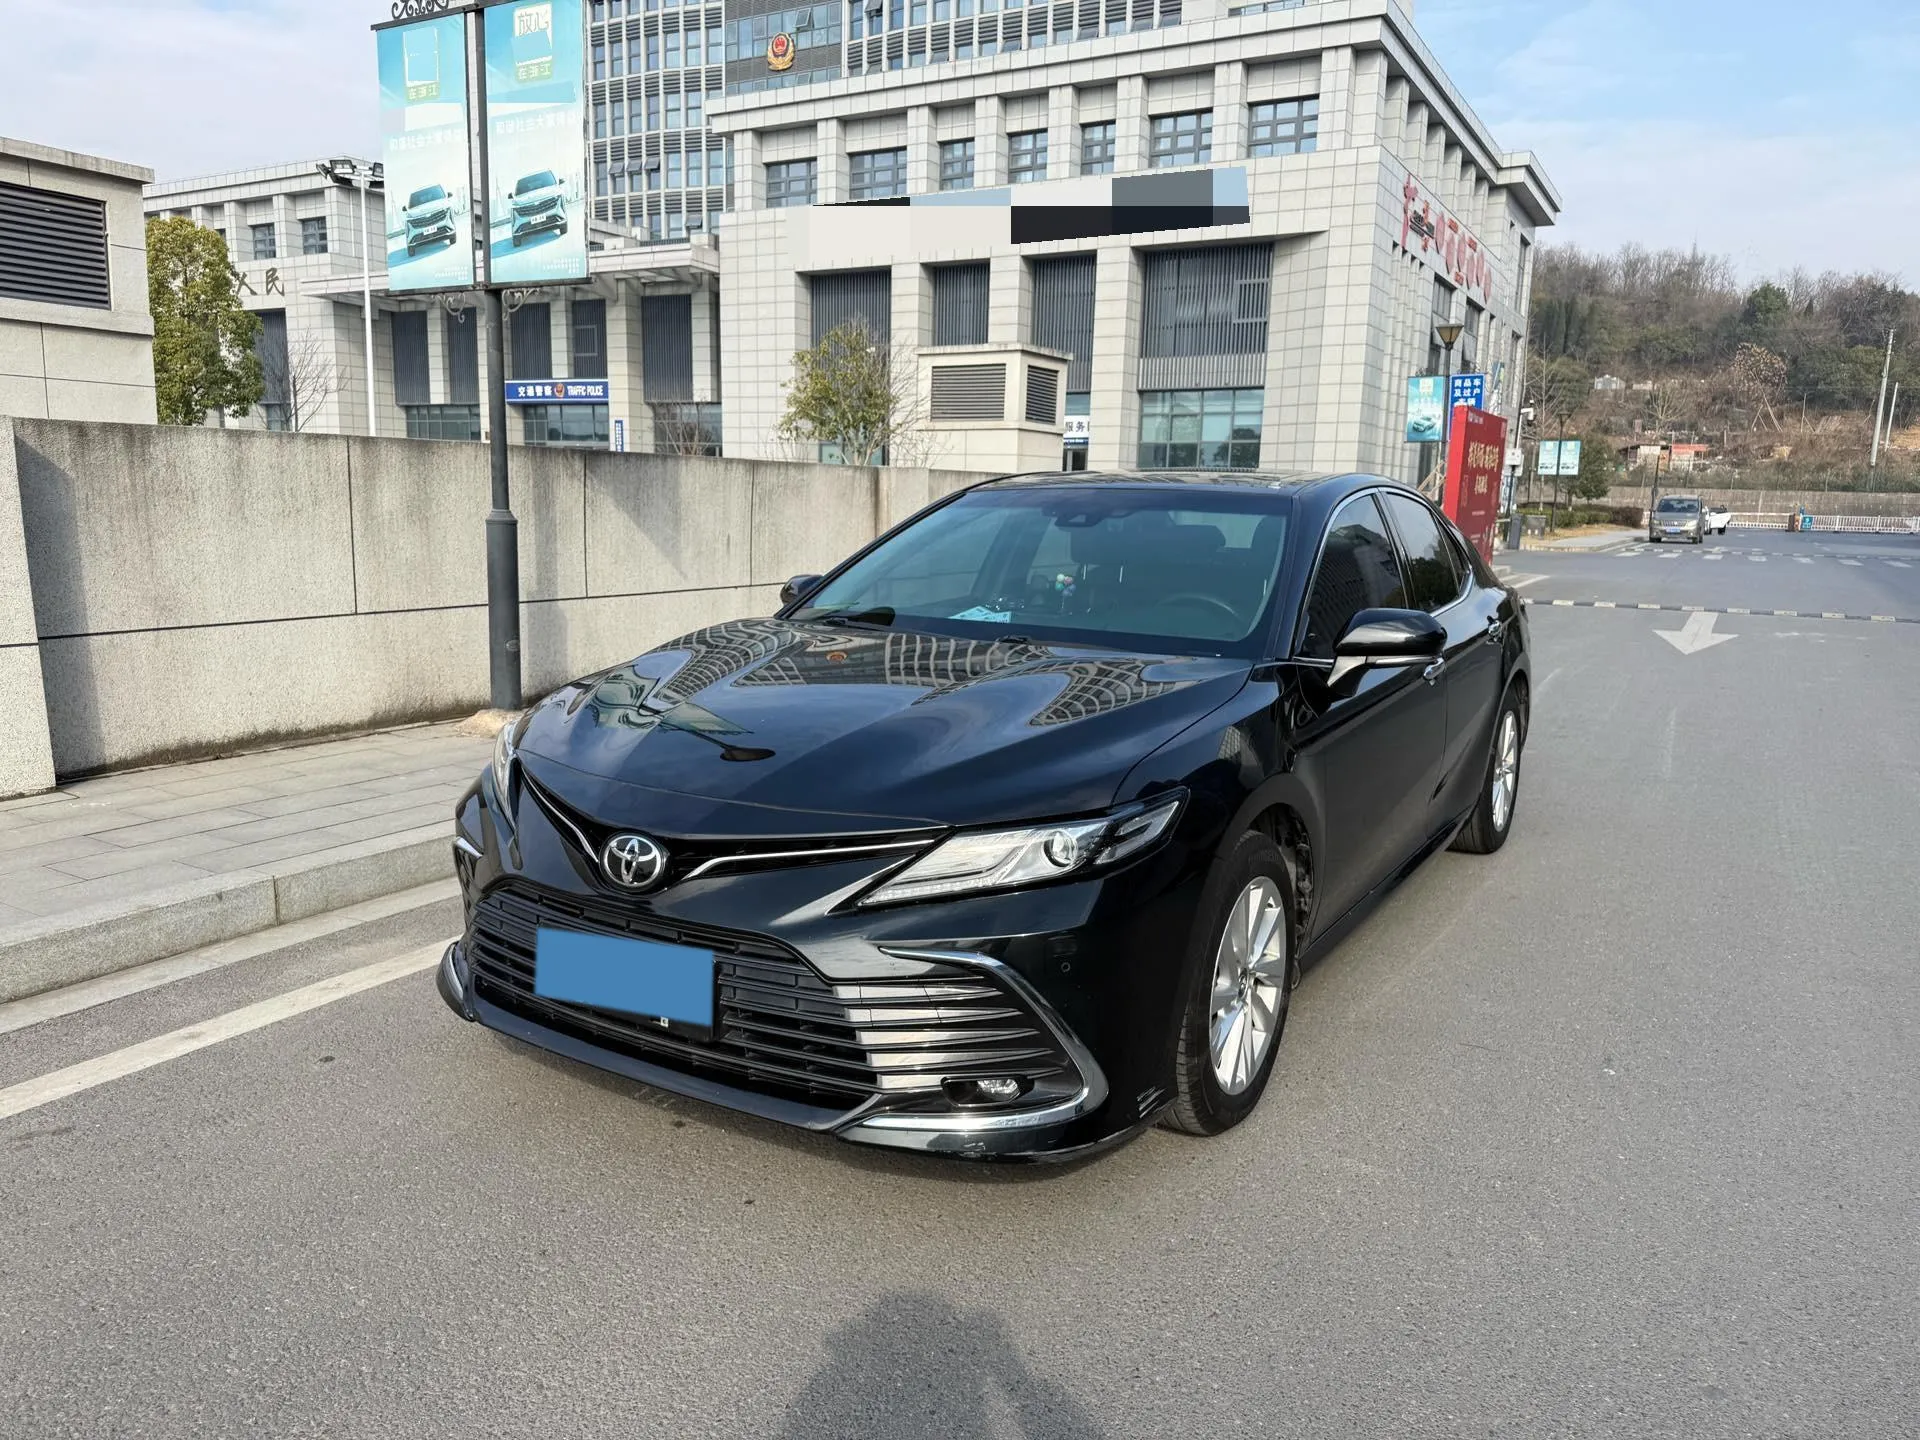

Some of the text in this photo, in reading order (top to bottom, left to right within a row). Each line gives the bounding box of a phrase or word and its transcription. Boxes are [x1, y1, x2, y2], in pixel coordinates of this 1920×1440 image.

[517, 385, 552, 397] 交通警察
[567, 385, 603, 396] TRAFFIC POLICE
[1065, 421, 1090, 432] 服务
